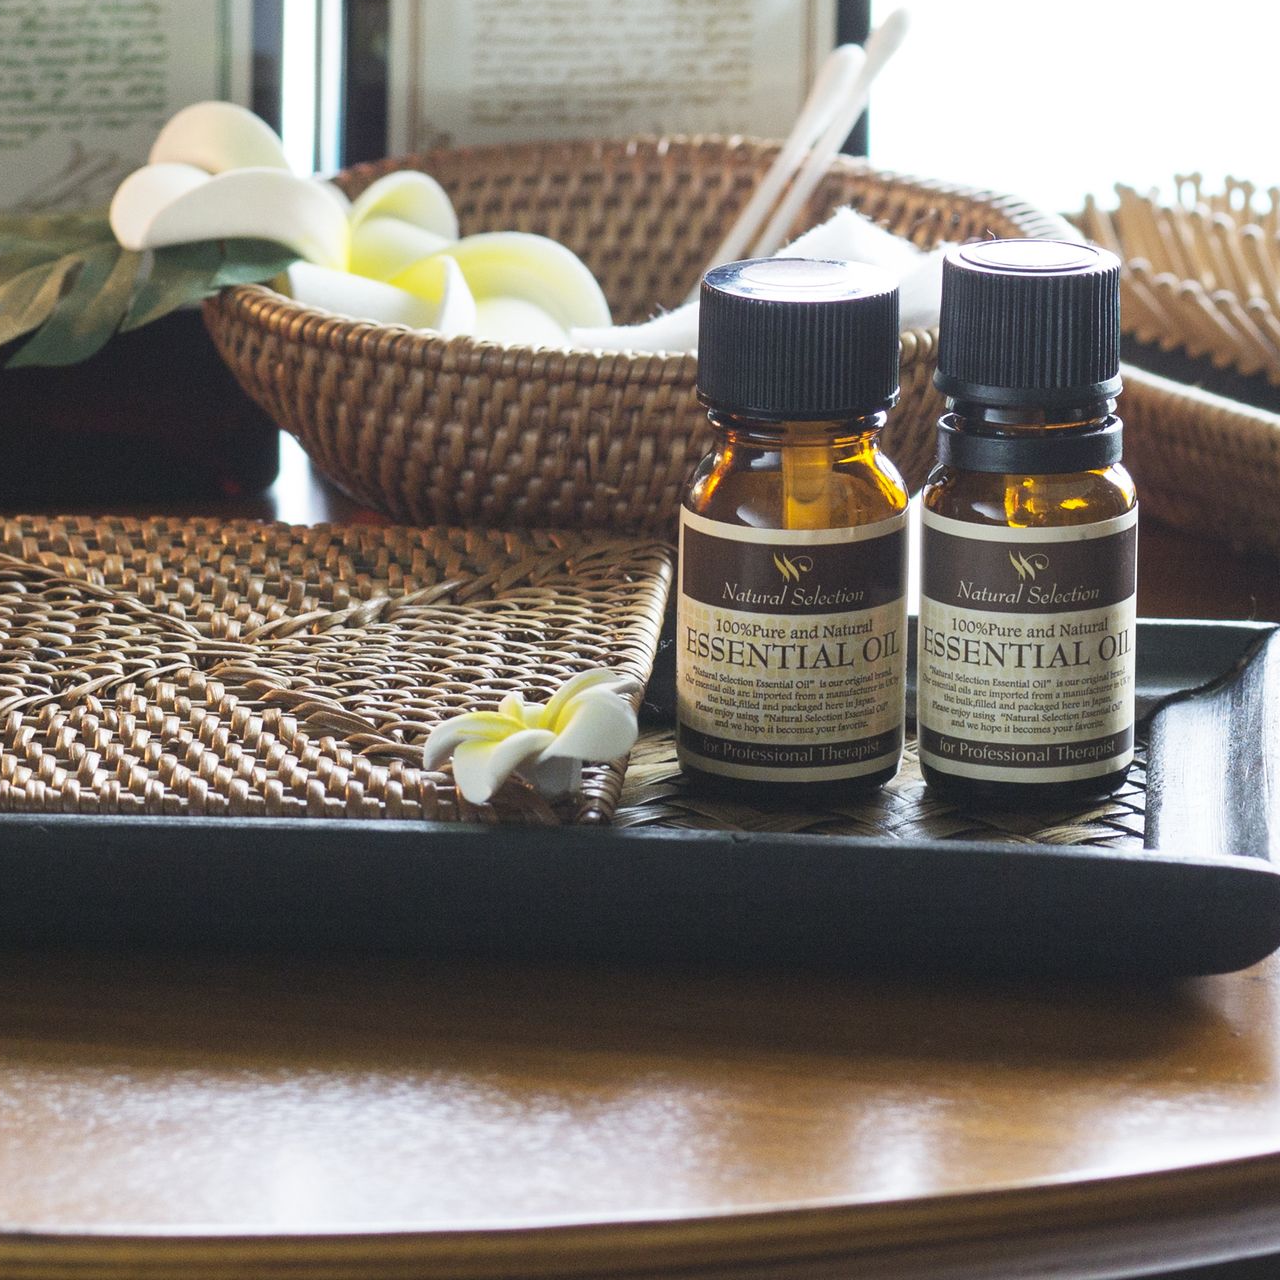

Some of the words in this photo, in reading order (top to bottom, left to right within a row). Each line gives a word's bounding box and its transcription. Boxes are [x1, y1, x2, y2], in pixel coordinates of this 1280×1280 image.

[722, 582, 787, 605] Natural
[791, 585, 864, 606] Selection
[957, 580, 1024, 604] Natural
[1027, 583, 1100, 605] Selection
[716, 619, 785, 639] 100%Pure
[790, 625, 818, 639] and
[823, 619, 873, 638] Natural
[952, 618, 1022, 638] 100%Pure
[1026, 624, 1055, 639] and
[1060, 617, 1109, 637] Natural
[686, 626, 855, 669] ESSENTIAL
[863, 630, 899, 662] OIL
[923, 626, 1091, 669] ESSENTIAL
[1098, 629, 1131, 661] OIL
[695, 679, 720, 693] essential
[722, 686, 735, 695] oils
[737, 689, 750, 697] are
[752, 690, 792, 701] imported
[795, 691, 816, 700] from
[818, 692, 824, 700] a
[826, 684, 877, 699] manufacturer
[719, 673, 753, 688] Selection
[756, 679, 793, 689] Essential
[819, 679, 826, 688] is
[828, 680, 843, 688] our
[844, 672, 874, 686] original
[932, 679, 957, 693] essential
[958, 685, 972, 695] oils
[973, 688, 987, 697] are
[989, 690, 1029, 701] imported
[1031, 691, 1053, 700] from
[1055, 691, 1061, 699] a
[1063, 683, 1113, 699] manufacturer
[955, 673, 990, 687] Selection
[992, 678, 1030, 689] Essential
[1056, 679, 1063, 688] is
[1065, 679, 1080, 687] our
[1081, 671, 1109, 686] original
[695, 701, 714, 714] Please
[714, 707, 734, 719] enjoy
[736, 711, 760, 723] using
[805, 711, 843, 723] Selection
[844, 706, 875, 720] Essential
[707, 694, 718, 704] the
[762, 702, 779, 711] and
[781, 702, 823, 713] packaged
[825, 702, 844, 710] here
[845, 699, 853, 708] in
[932, 700, 950, 713] Please
[951, 707, 971, 719] enjoy
[972, 711, 996, 723] using
[1041, 711, 1080, 722] Selection
[1081, 705, 1111, 719] Essential
[943, 693, 955, 703] the
[999, 701, 1016, 710] and
[1018, 701, 1060, 713] packaged
[1062, 701, 1080, 710] here
[1082, 698, 1090, 708] in
[714, 720, 729, 728] and
[730, 722, 743, 730] we
[744, 722, 765, 734] hope
[767, 725, 774, 733] it
[776, 724, 814, 734] becomes
[815, 724, 837, 735] your
[950, 719, 965, 728] and
[967, 722, 979, 731] we
[980, 722, 1002, 734] hope
[1004, 724, 1011, 733] it
[1013, 723, 1051, 734] becomes
[1053, 723, 1074, 735] your
[703, 737, 720, 753] for
[723, 742, 813, 762] Professional
[819, 740, 880, 761] Therapist
[940, 737, 956, 754] for
[960, 742, 1050, 762] Professional
[1056, 740, 1115, 761] Therapist
